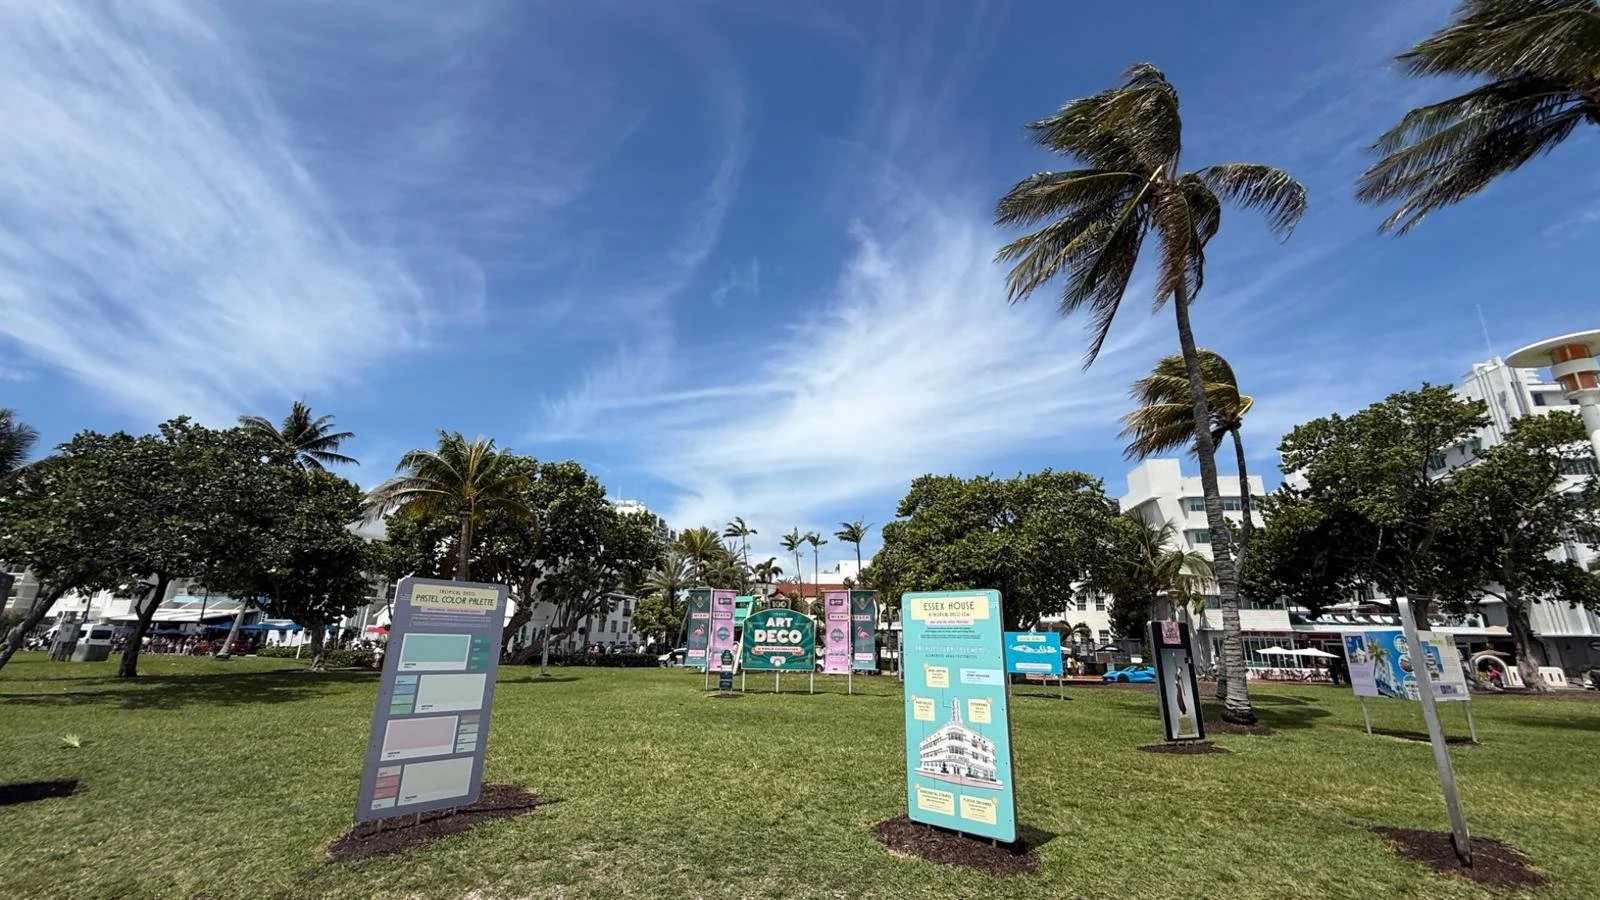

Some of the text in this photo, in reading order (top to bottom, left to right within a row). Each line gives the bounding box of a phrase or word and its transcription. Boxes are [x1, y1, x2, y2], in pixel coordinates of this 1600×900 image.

[415, 594, 495, 606] PASTEL COLOR PALETTE
[923, 601, 975, 611] ESSEX HOUSE
[766, 617, 793, 627] ART
[754, 629, 802, 644] DECO
